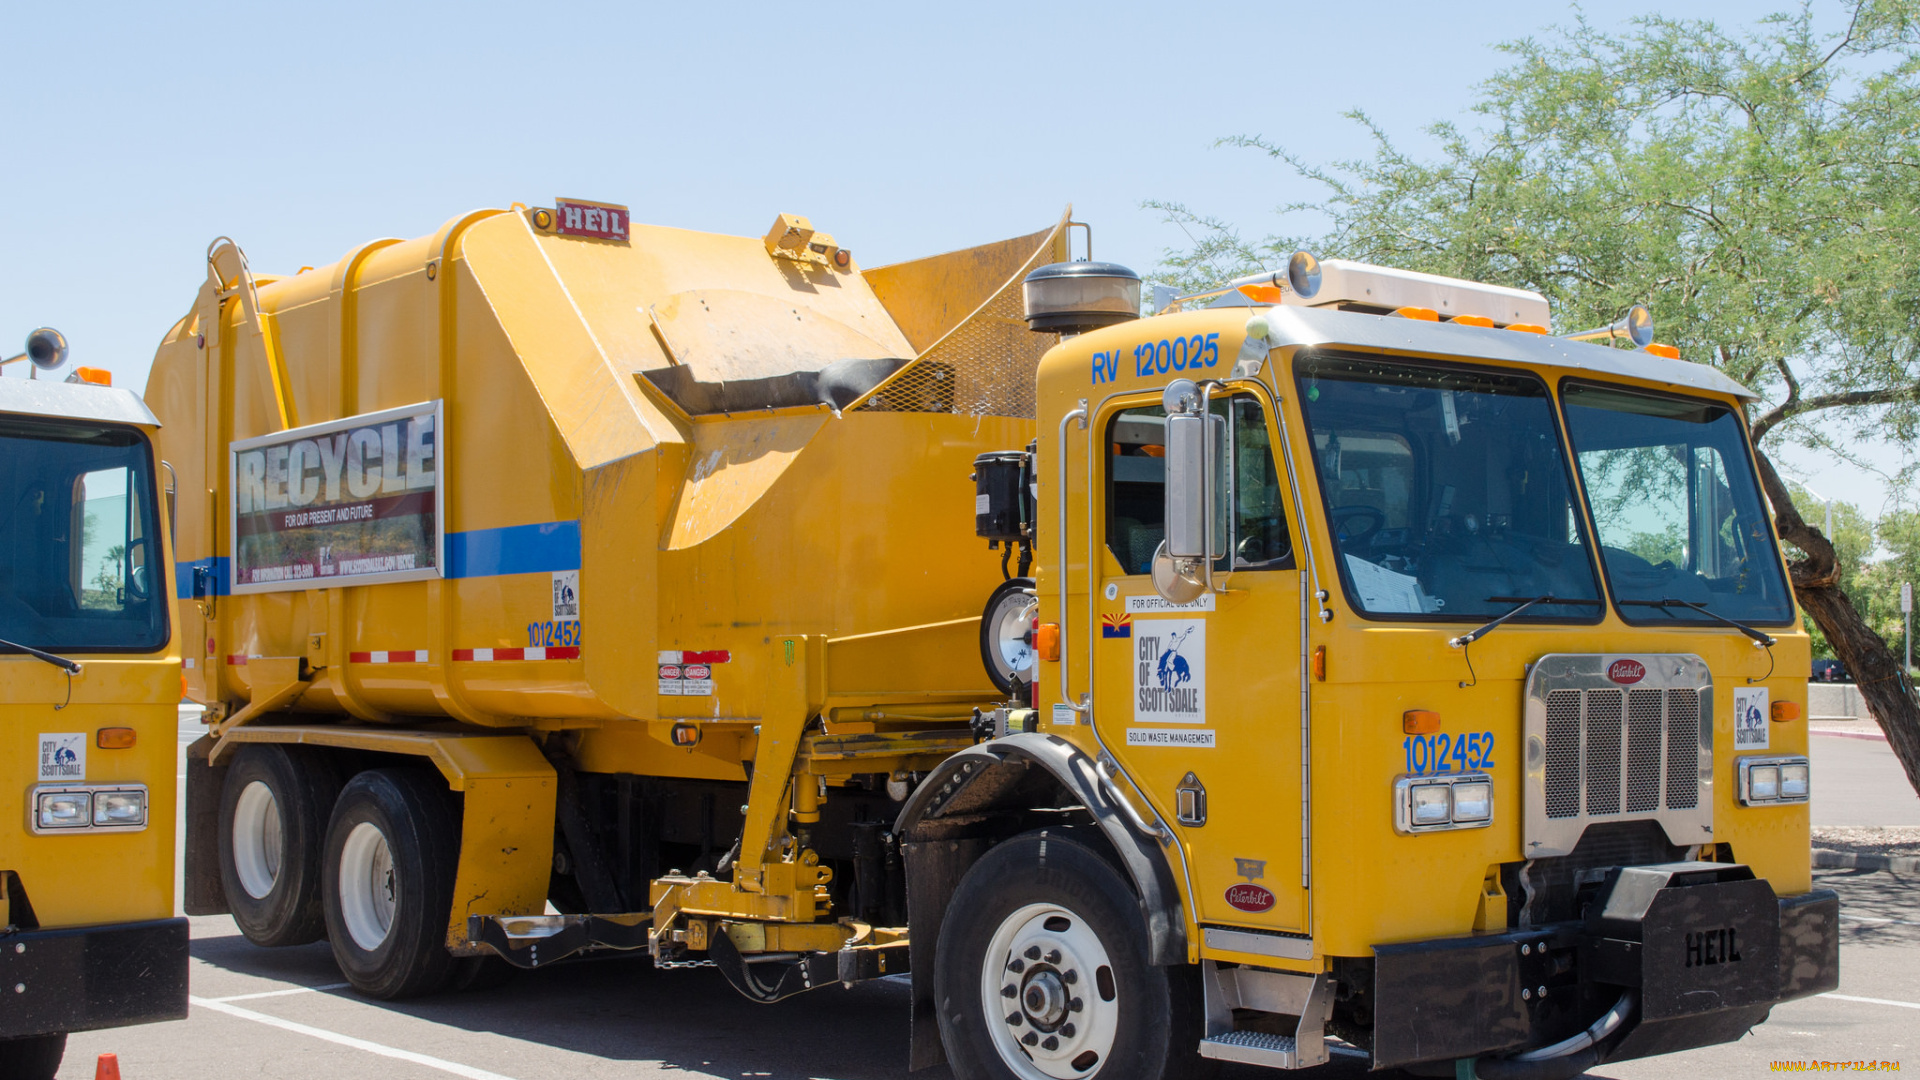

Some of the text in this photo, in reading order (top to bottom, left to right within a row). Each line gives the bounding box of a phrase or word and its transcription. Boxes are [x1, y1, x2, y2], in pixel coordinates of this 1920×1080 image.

[564, 206, 625, 235] HEIL
[1092, 332, 1220, 385] RV 120025
[238, 414, 435, 514] RECYCLE
[285, 503, 373, 528] FOR OUR PRESENT AND FUTURE
[554, 579, 563, 592] CITY
[554, 592, 560, 604] OF
[1132, 599, 1145, 609] FOR
[1146, 598, 1175, 609] OFFICIAL
[554, 603, 577, 617] SCOTTSDALE
[527, 620, 581, 648] 1012452
[1139, 636, 1160, 661] CITY
[660, 668, 680, 677] DANGER
[685, 668, 708, 677] DANGER
[1139, 662, 1150, 686] OF
[1612, 663, 1643, 679] Peterbilt
[1139, 687, 1198, 713] SCOTTSDALE
[1736, 697, 1747, 712] CITY
[1736, 713, 1742, 728] OF
[1129, 732, 1213, 744] SOLID WASTE MANAGEMENT
[1736, 728, 1766, 744] SCOTTSDALE
[42, 741, 57, 752] CITY
[1403, 731, 1495, 773] 1012452
[42, 753, 50, 765] OF
[42, 764, 81, 776] SCOTTSDALE
[1230, 888, 1270, 905] Peterbilt
[1685, 927, 1741, 968] HEIL
